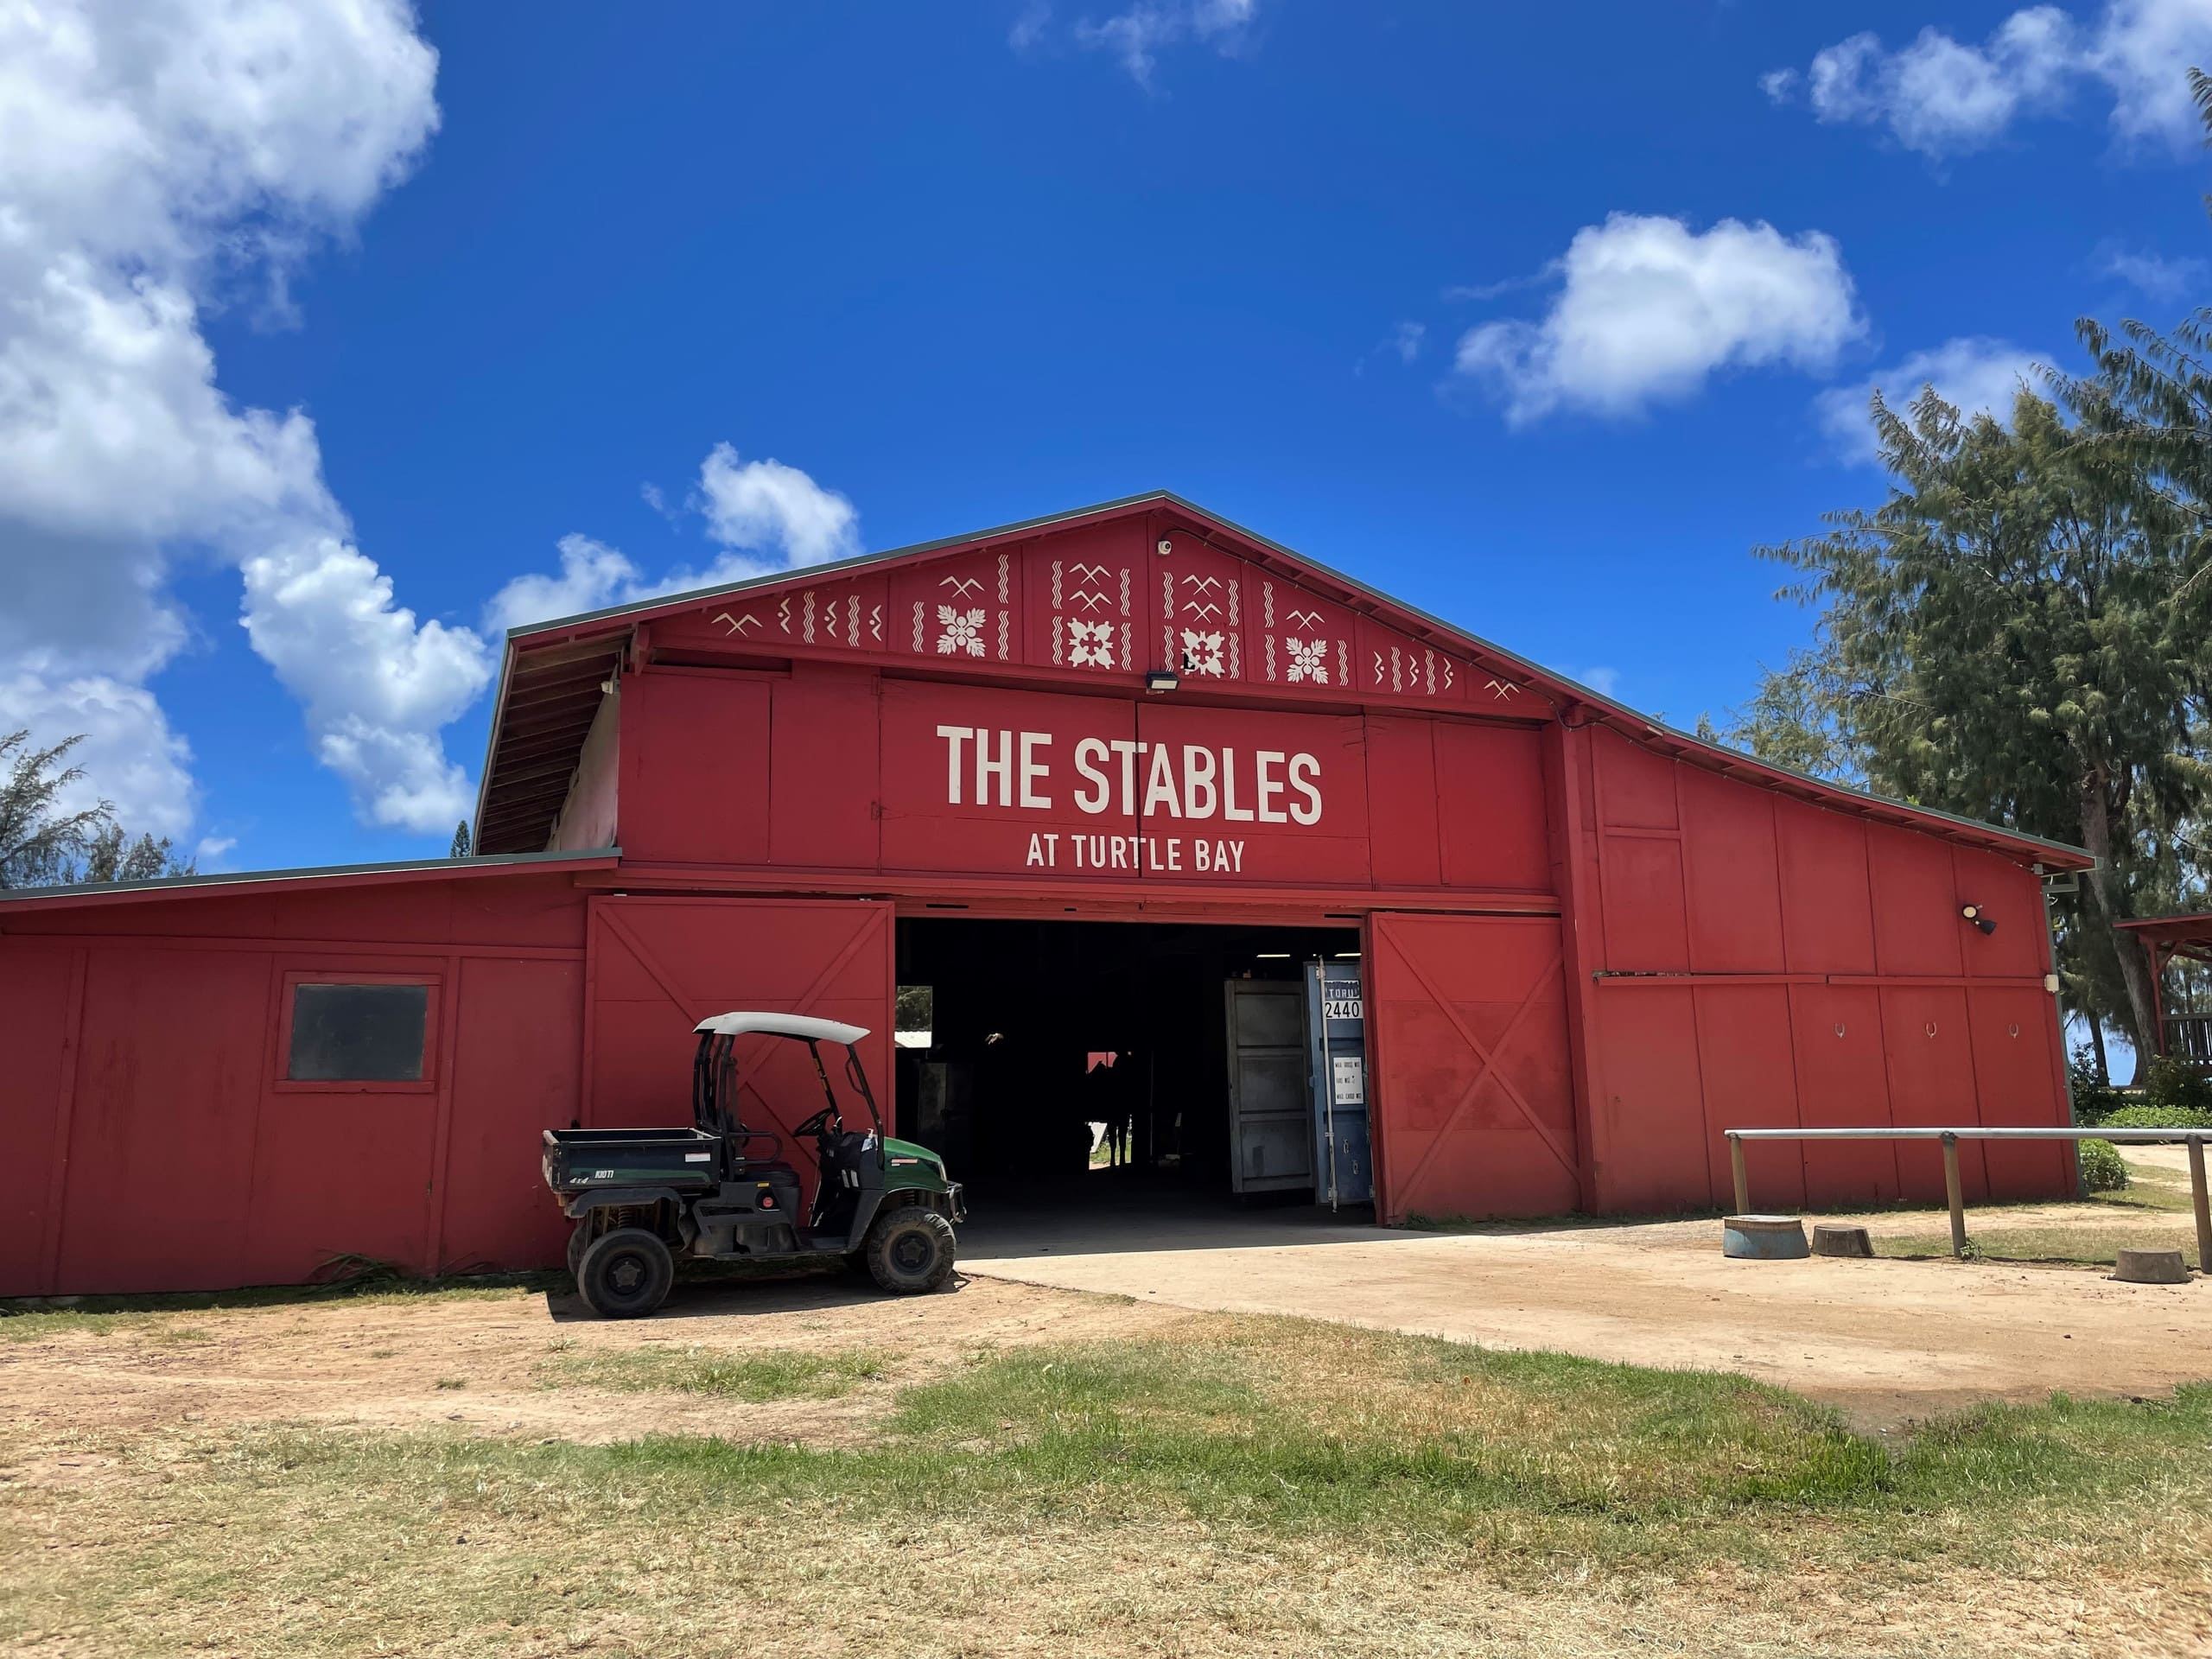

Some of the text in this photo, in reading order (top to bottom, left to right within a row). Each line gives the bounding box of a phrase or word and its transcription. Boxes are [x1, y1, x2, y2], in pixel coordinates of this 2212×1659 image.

[937, 725, 1322, 825] THE STABLES
[1027, 832, 1244, 873] AT TURTLE BAY
[1325, 1001, 1359, 1018] 2440
[594, 1170, 613, 1179] KIOTI
